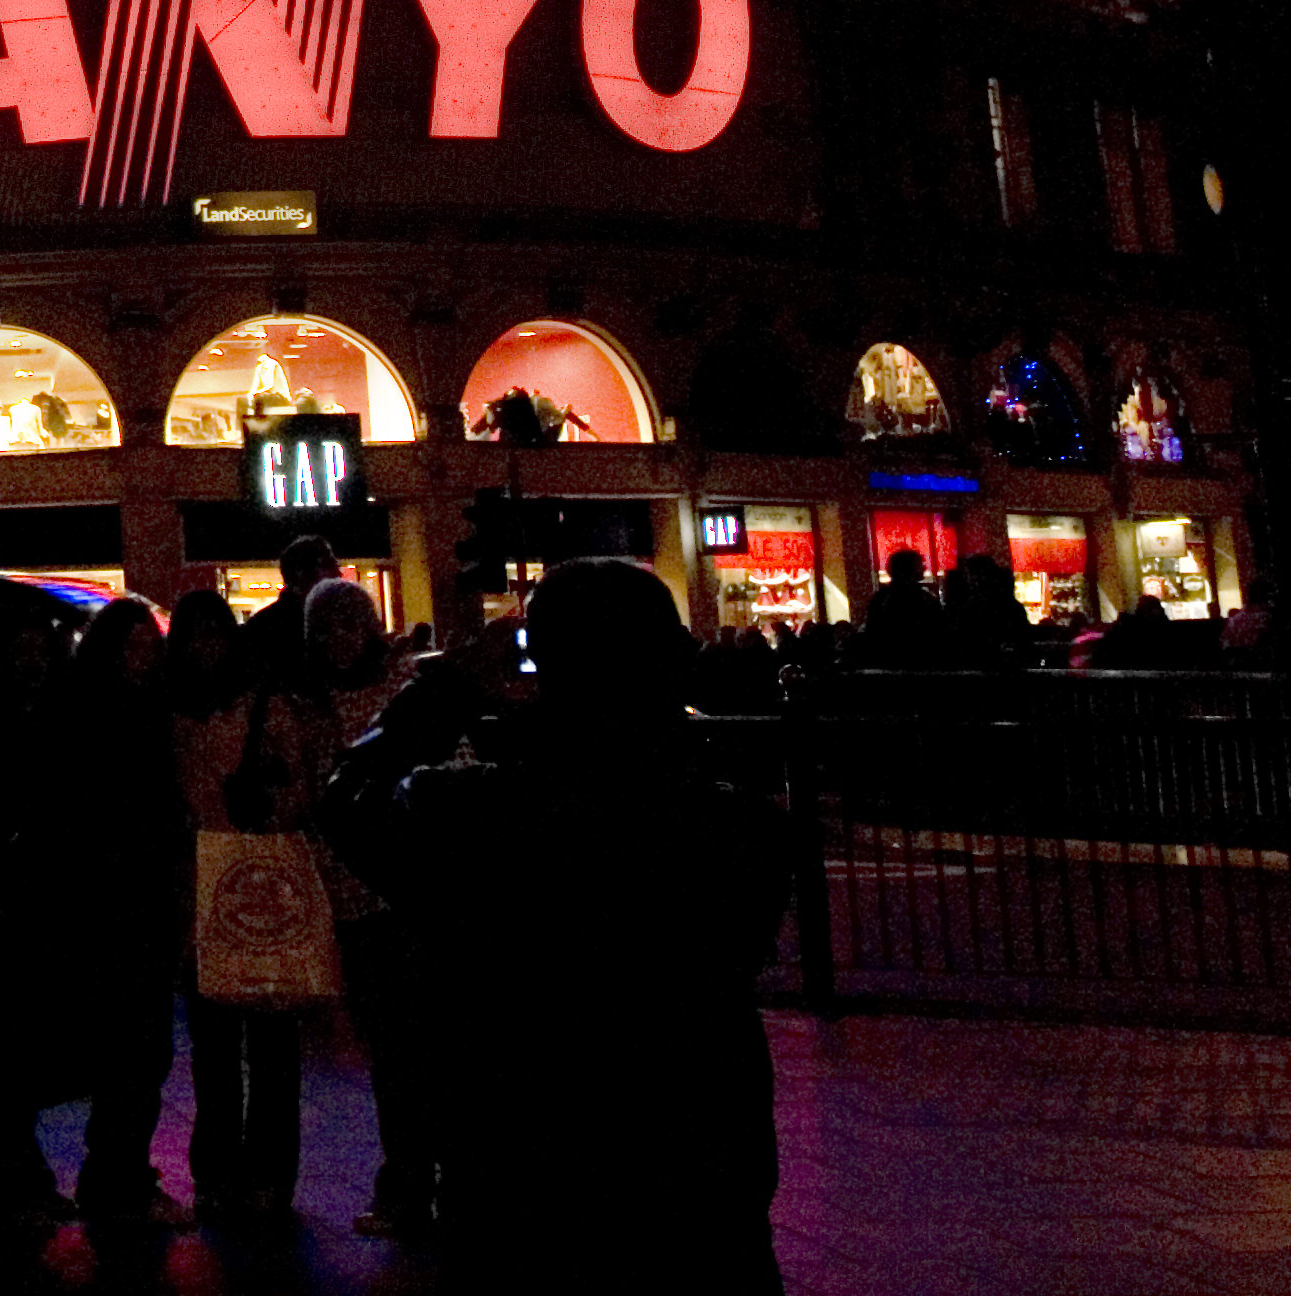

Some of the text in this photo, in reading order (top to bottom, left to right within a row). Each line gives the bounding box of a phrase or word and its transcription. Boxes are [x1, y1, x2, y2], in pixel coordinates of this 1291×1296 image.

[202, 205, 305, 223] LandSecurities
[262, 440, 347, 508] GAP
[703, 515, 738, 546] GAP
